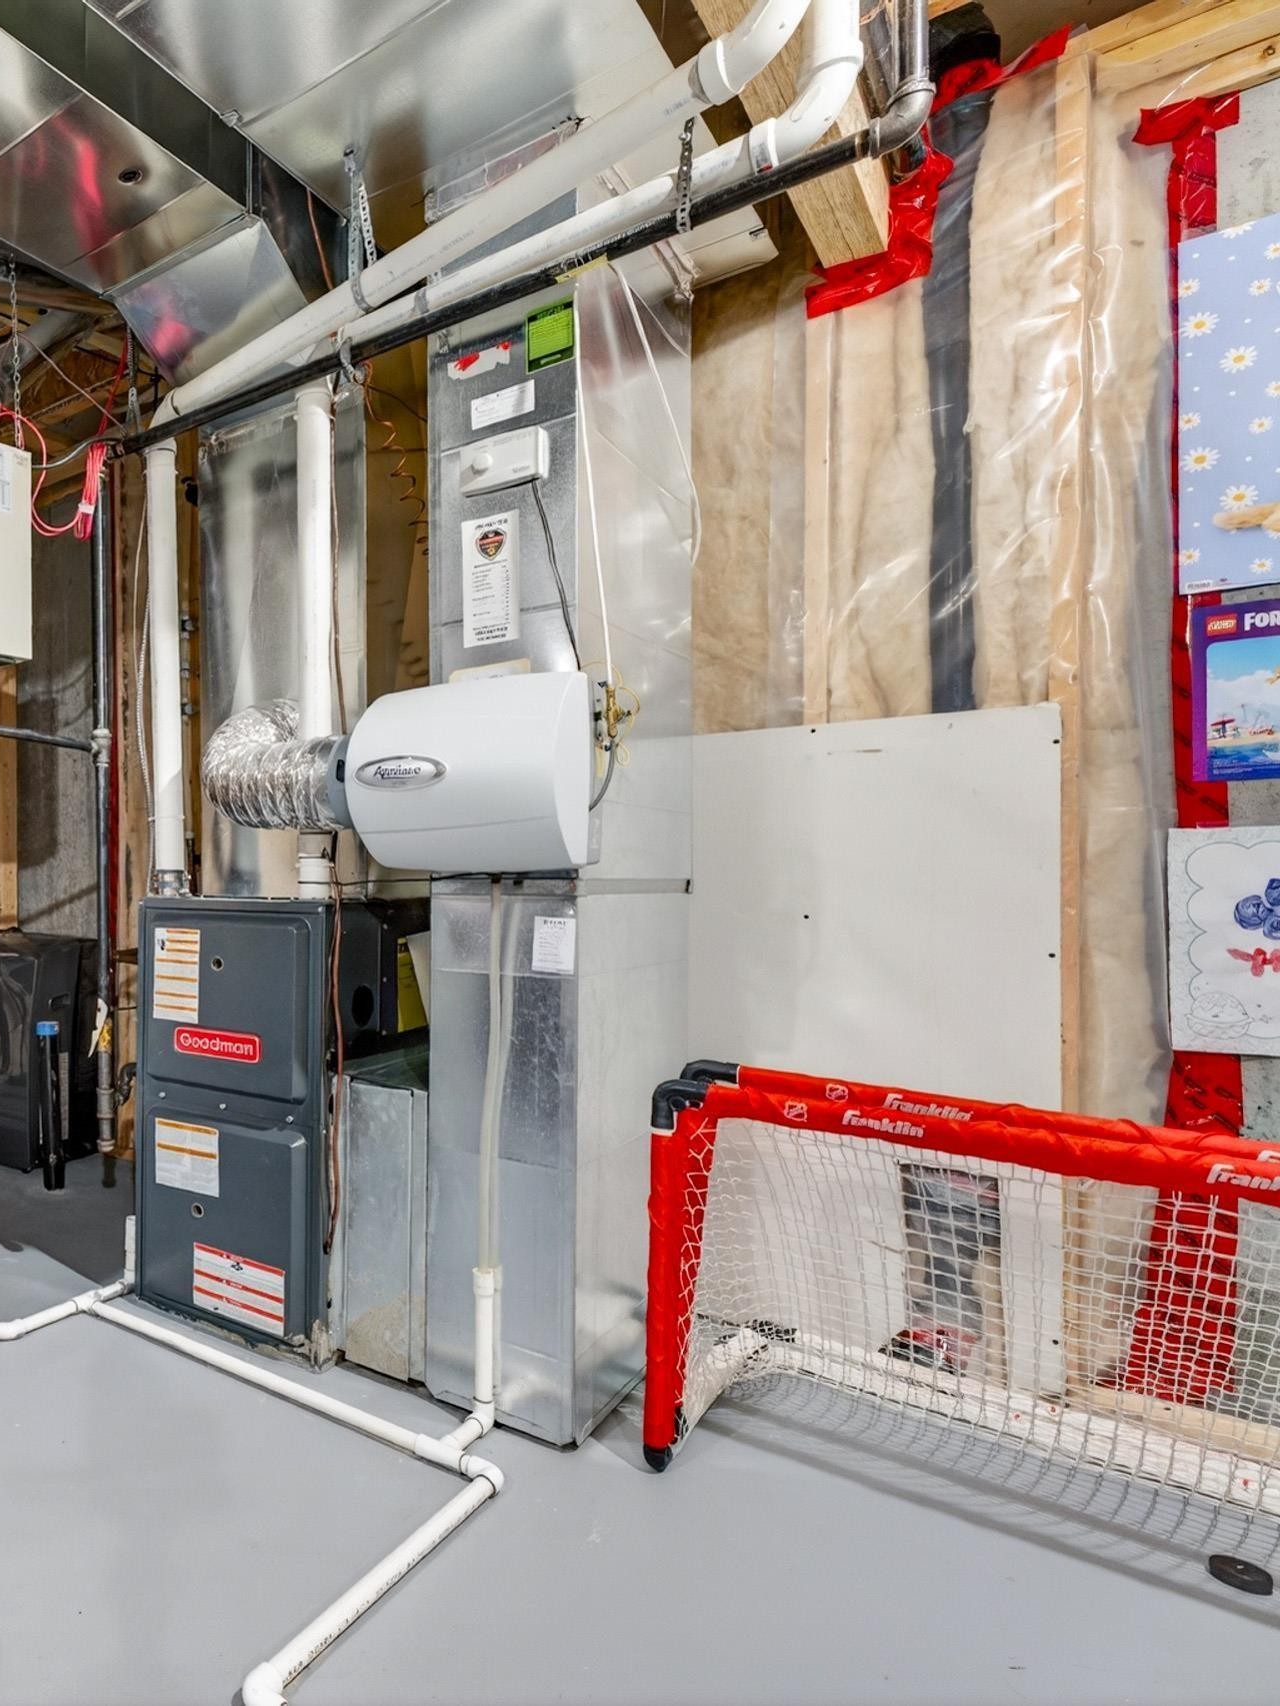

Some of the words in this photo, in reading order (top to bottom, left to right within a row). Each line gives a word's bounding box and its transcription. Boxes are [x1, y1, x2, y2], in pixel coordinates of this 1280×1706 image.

[180, 1032, 255, 1056] Goodman
[882, 1093, 974, 1121] Franklin
[841, 1109, 926, 1137] Franklin
